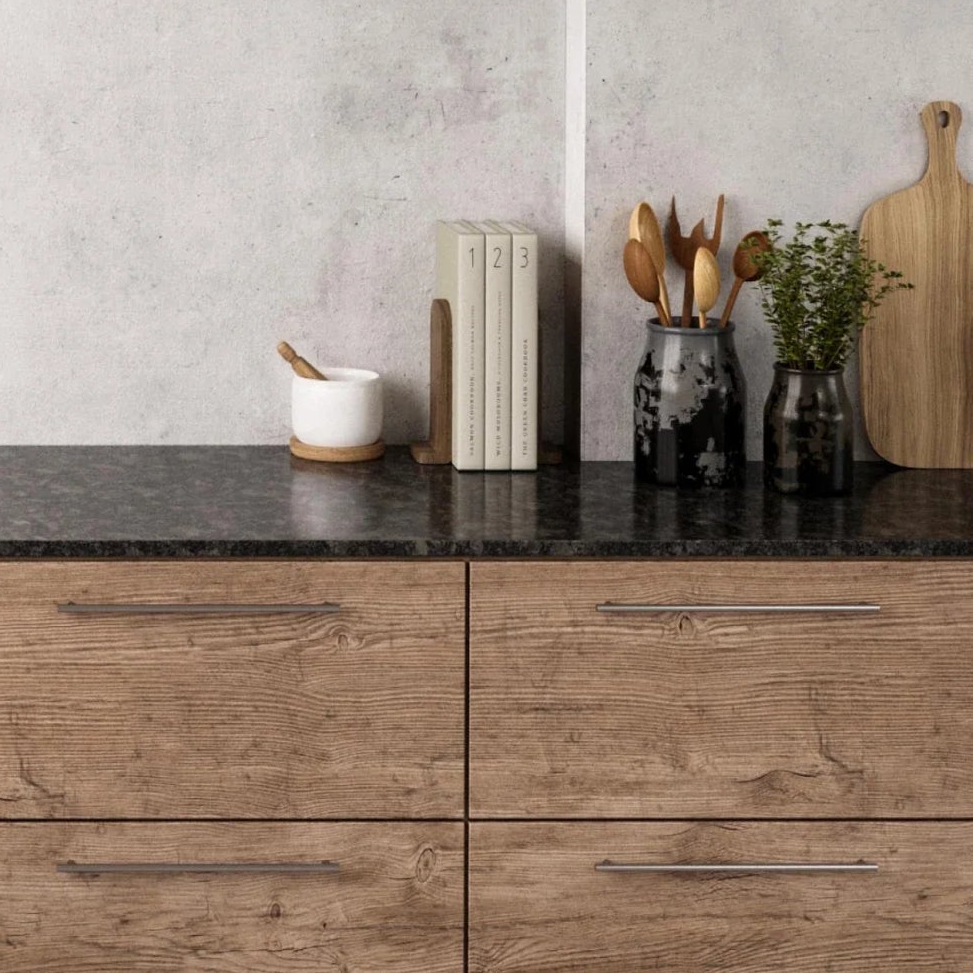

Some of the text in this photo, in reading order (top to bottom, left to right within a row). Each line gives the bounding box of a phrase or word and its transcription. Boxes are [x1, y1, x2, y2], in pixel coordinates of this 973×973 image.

[468, 247, 475, 268] 1
[493, 247, 502, 268] 2
[519, 247, 529, 268] 3
